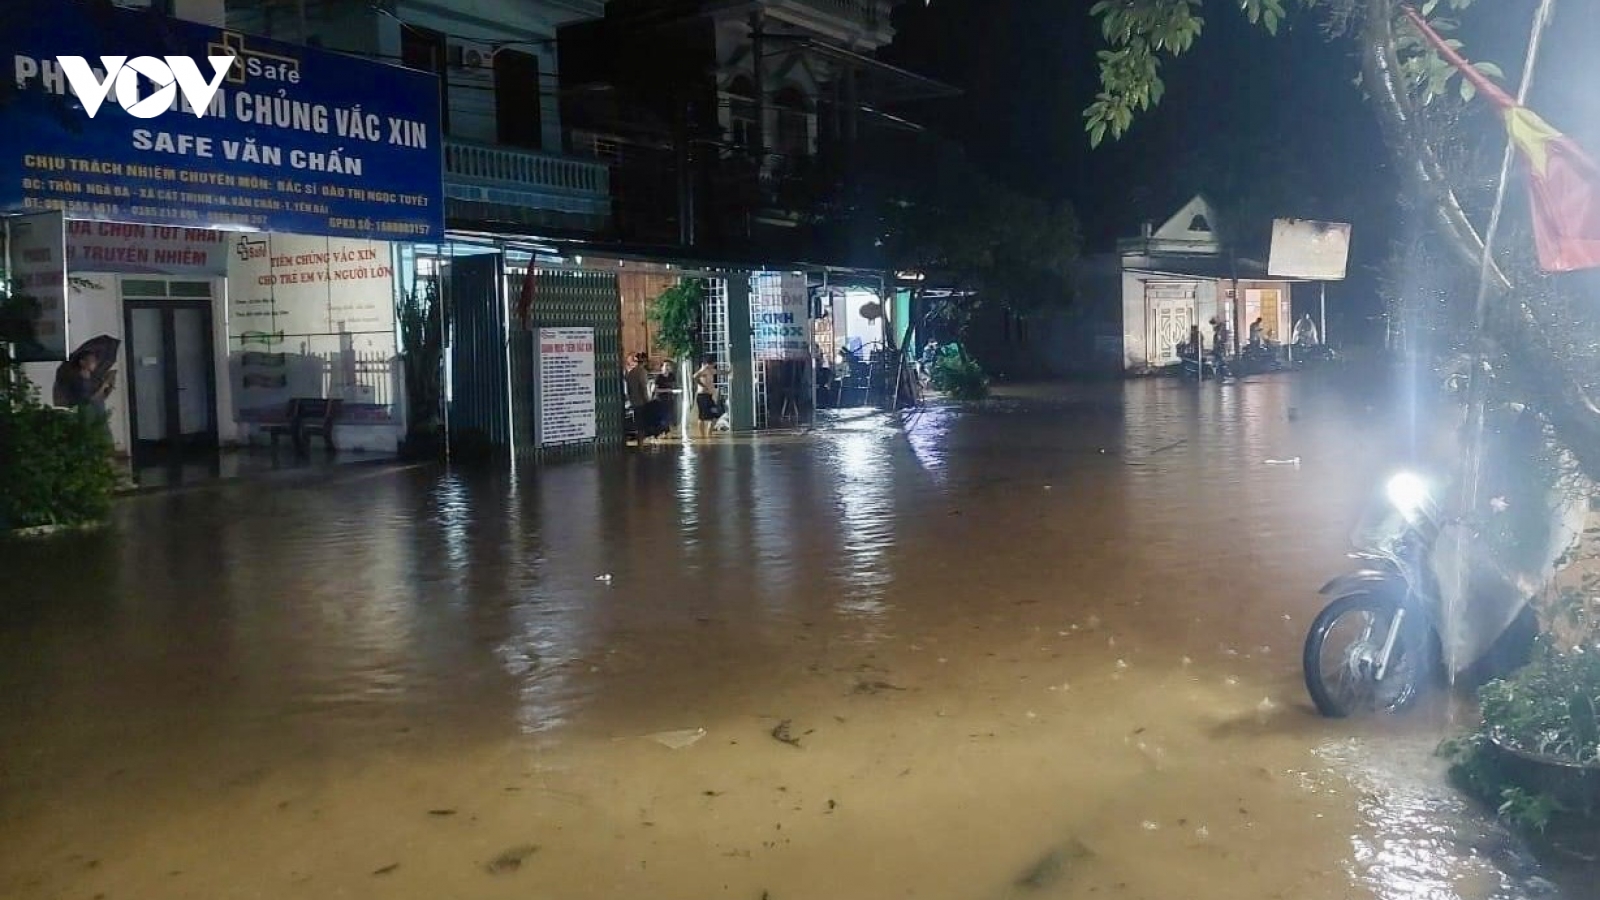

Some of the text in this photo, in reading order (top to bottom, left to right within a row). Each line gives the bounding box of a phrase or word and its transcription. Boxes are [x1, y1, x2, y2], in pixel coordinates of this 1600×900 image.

[247, 57, 300, 84] Safe
[236, 89, 329, 134] CHỦNG
[335, 103, 381, 142] VẮC
[388, 117, 427, 149] XIN
[132, 128, 362, 176] SAFE VĂN CHẤN
[24, 154, 65, 171] CHỊU
[69, 157, 122, 176] TRÁCH
[348, 188, 365, 202] THỊ
[357, 248, 376, 260] XIN
[258, 275, 278, 286] CHO
[301, 273, 315, 284] EM
